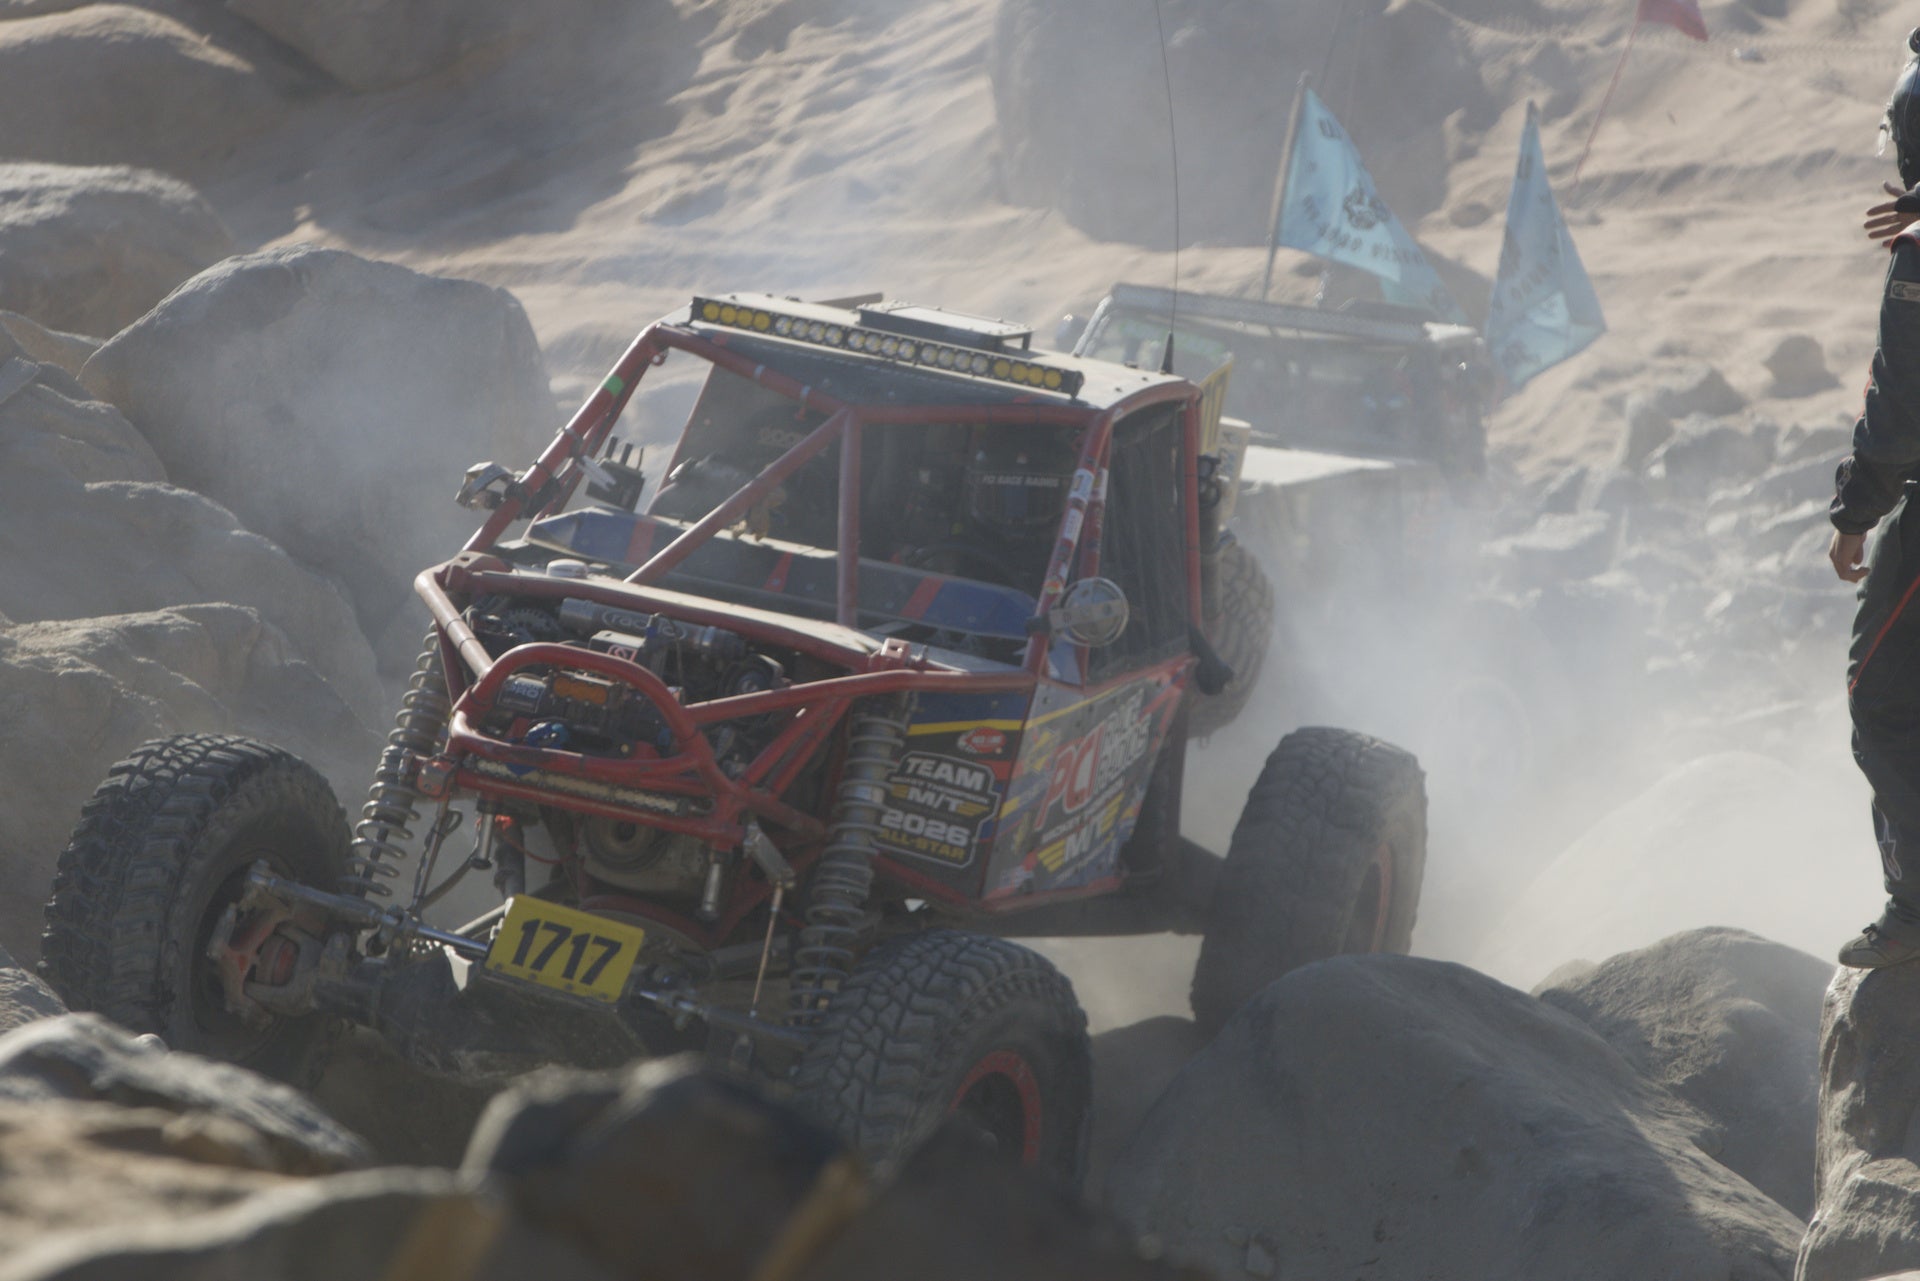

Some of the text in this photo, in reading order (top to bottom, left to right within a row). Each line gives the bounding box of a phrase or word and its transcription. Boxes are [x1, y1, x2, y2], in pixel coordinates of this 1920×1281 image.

[905, 757, 986, 791] TEAM
[1033, 720, 1107, 832] PCI
[907, 787, 965, 813] M/T
[879, 828, 966, 861] ALL-STAR
[880, 809, 972, 848] 2026
[511, 918, 623, 986] 1717
